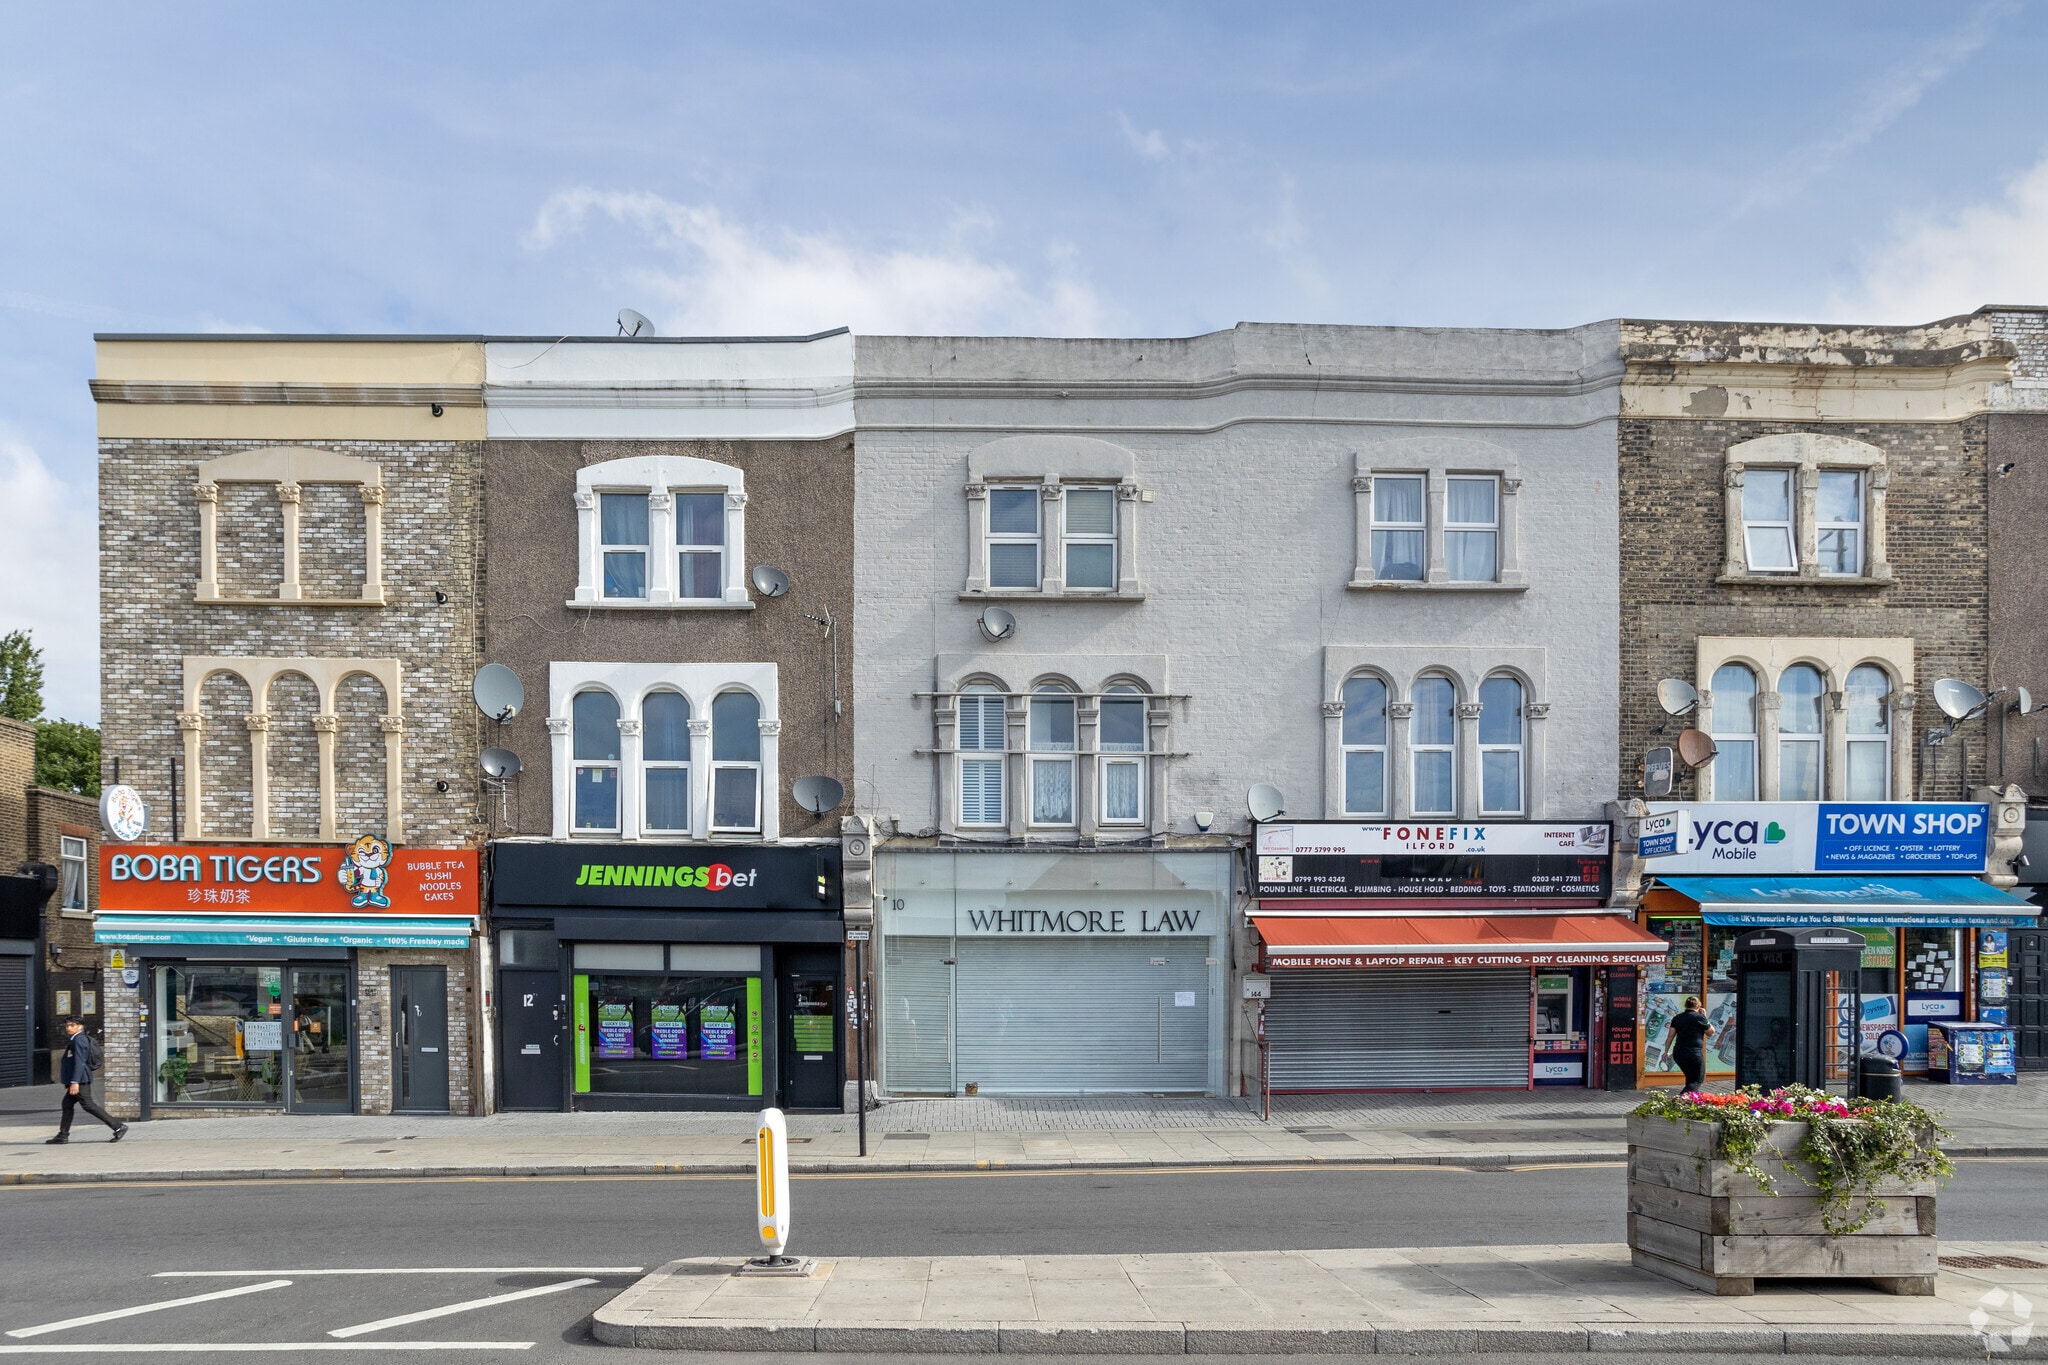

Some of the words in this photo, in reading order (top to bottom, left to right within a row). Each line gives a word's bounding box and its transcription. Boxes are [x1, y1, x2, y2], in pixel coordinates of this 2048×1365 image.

[1647, 762, 1671, 772] REEVES
[1646, 819, 1665, 830] Lyca
[1826, 814, 1905, 834] TOWN
[1912, 813, 1982, 834] SHOP
[1383, 827, 1486, 840] FONEFIX
[1689, 821, 1758, 850] yca
[1643, 838, 1659, 847] TOWN
[1660, 836, 1674, 845] SHOP
[1654, 845, 1671, 853] LICENCE
[1712, 848, 1756, 859] Mobile
[110, 854, 201, 882] BOBA
[208, 855, 322, 883] TIGERS
[407, 862, 442, 870] BUBBLE
[444, 861, 464, 869] TEA
[425, 872, 452, 880] SUSHI
[420, 882, 462, 891] NOODLES
[1751, 884, 1922, 898] Lycamobile
[188, 888, 250, 904] 珍珠奶茶
[424, 892, 454, 901] CAKES
[893, 899, 904, 910] 10
[968, 910, 1125, 932] WHITMORE
[1141, 910, 1201, 932] LAW
[410, 937, 442, 946] Freshley
[1861, 946, 1875, 954] EVEN
[1877, 946, 1894, 954] KINGS
[1612, 955, 1666, 963] SPECIALIST
[1866, 955, 1892, 966] STORE
[524, 994, 534, 1007] 12
[1866, 1004, 1888, 1015] oyster
[1922, 1003, 1939, 1011] Lyca
